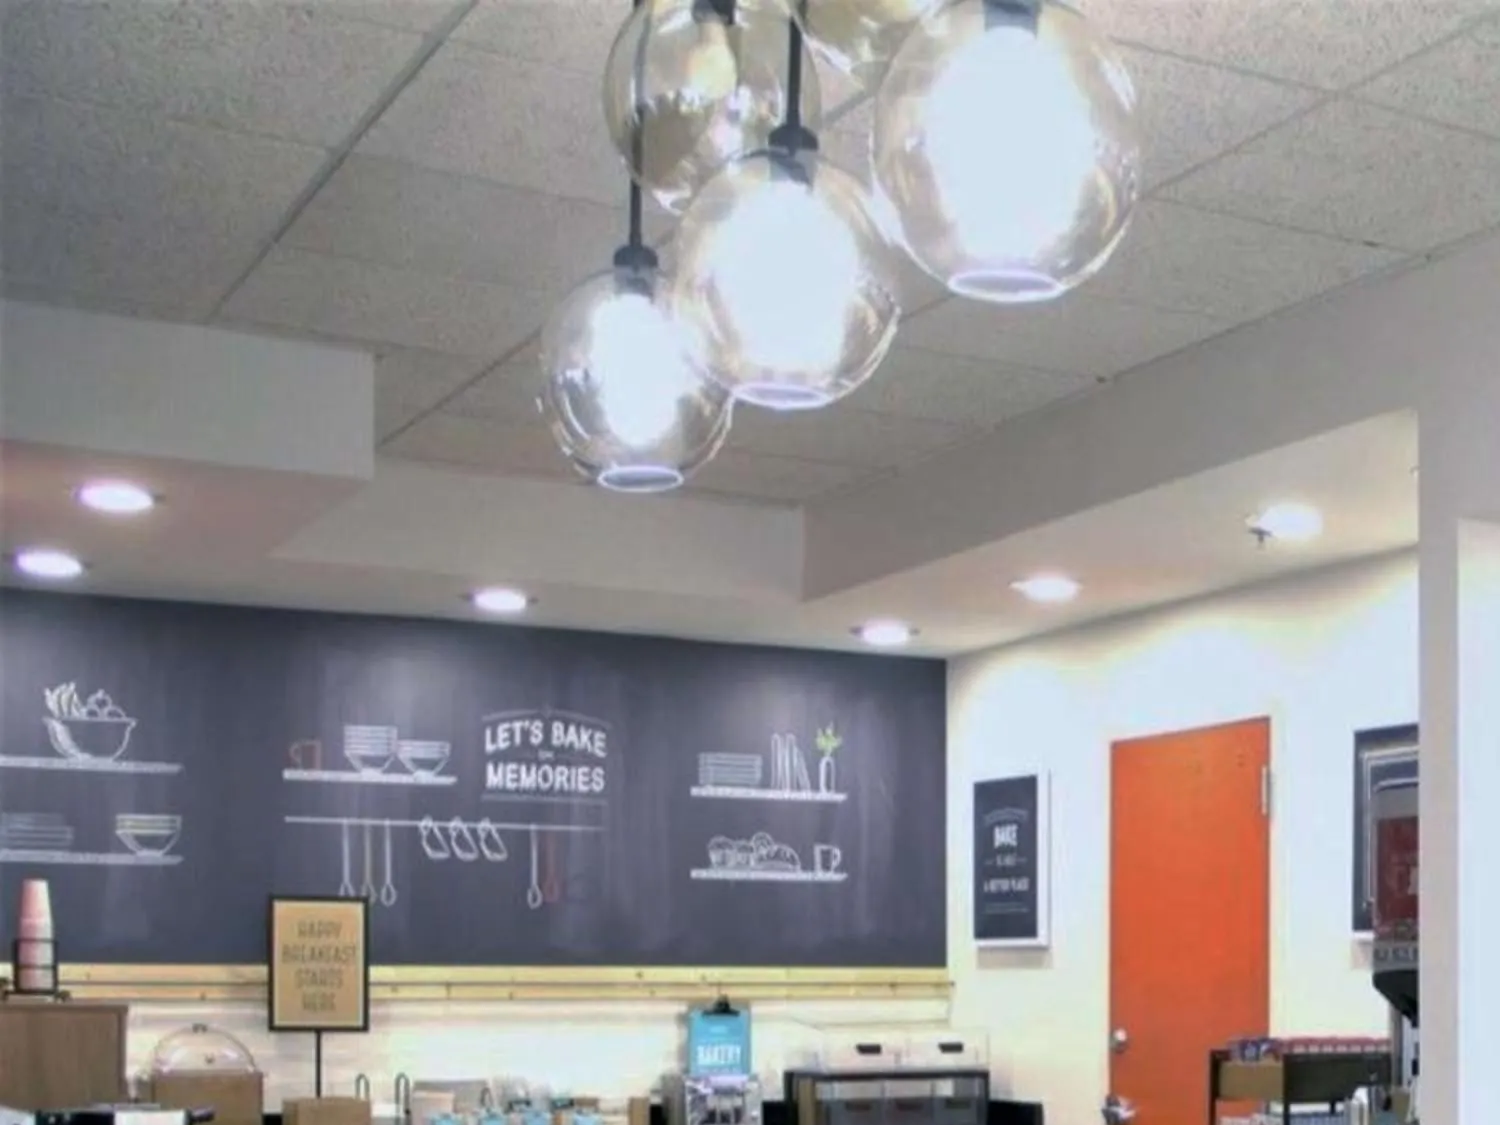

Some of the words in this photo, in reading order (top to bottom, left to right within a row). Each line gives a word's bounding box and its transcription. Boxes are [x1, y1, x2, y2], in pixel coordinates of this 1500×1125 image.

[485, 720, 544, 755] LET'S
[551, 721, 607, 758] BAKE
[485, 763, 606, 793] MEMORIES
